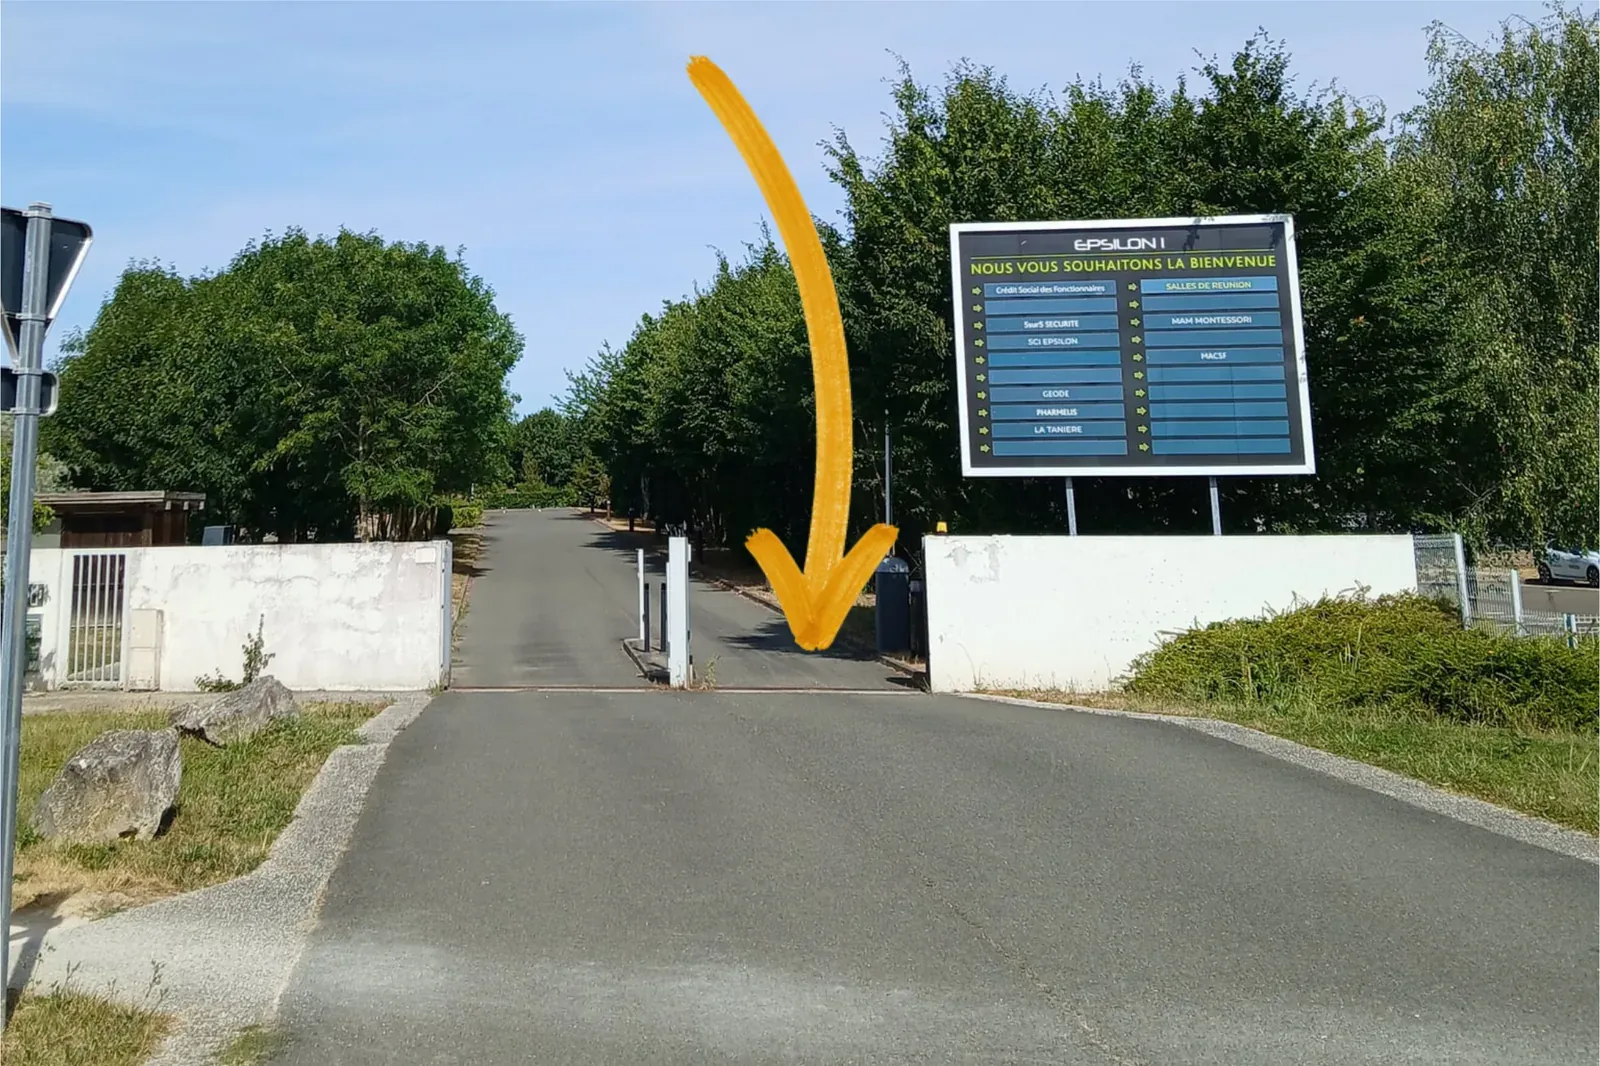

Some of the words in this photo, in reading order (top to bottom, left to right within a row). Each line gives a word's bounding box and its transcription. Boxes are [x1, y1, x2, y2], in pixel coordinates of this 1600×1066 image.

[1074, 237, 1156, 250] EPSILON
[970, 262, 1013, 274] NOUS
[1016, 260, 1058, 274] VOUS
[1064, 258, 1162, 272] SOUHAITONS
[1168, 257, 1186, 270] LA
[1190, 255, 1276, 268] BIENVENUE
[996, 286, 1018, 294] Crédit
[1018, 286, 1039, 294] Social
[1054, 284, 1105, 292] Fonctionnaires
[1166, 282, 1196, 290] SALLES
[1212, 281, 1252, 289] REUNION
[1195, 316, 1252, 324] MONTESSORI
[1028, 338, 1042, 346] SCI
[1042, 338, 1078, 346] EPSILON
[1042, 390, 1070, 398] GEODE
[1046, 425, 1084, 434] TANIERE
